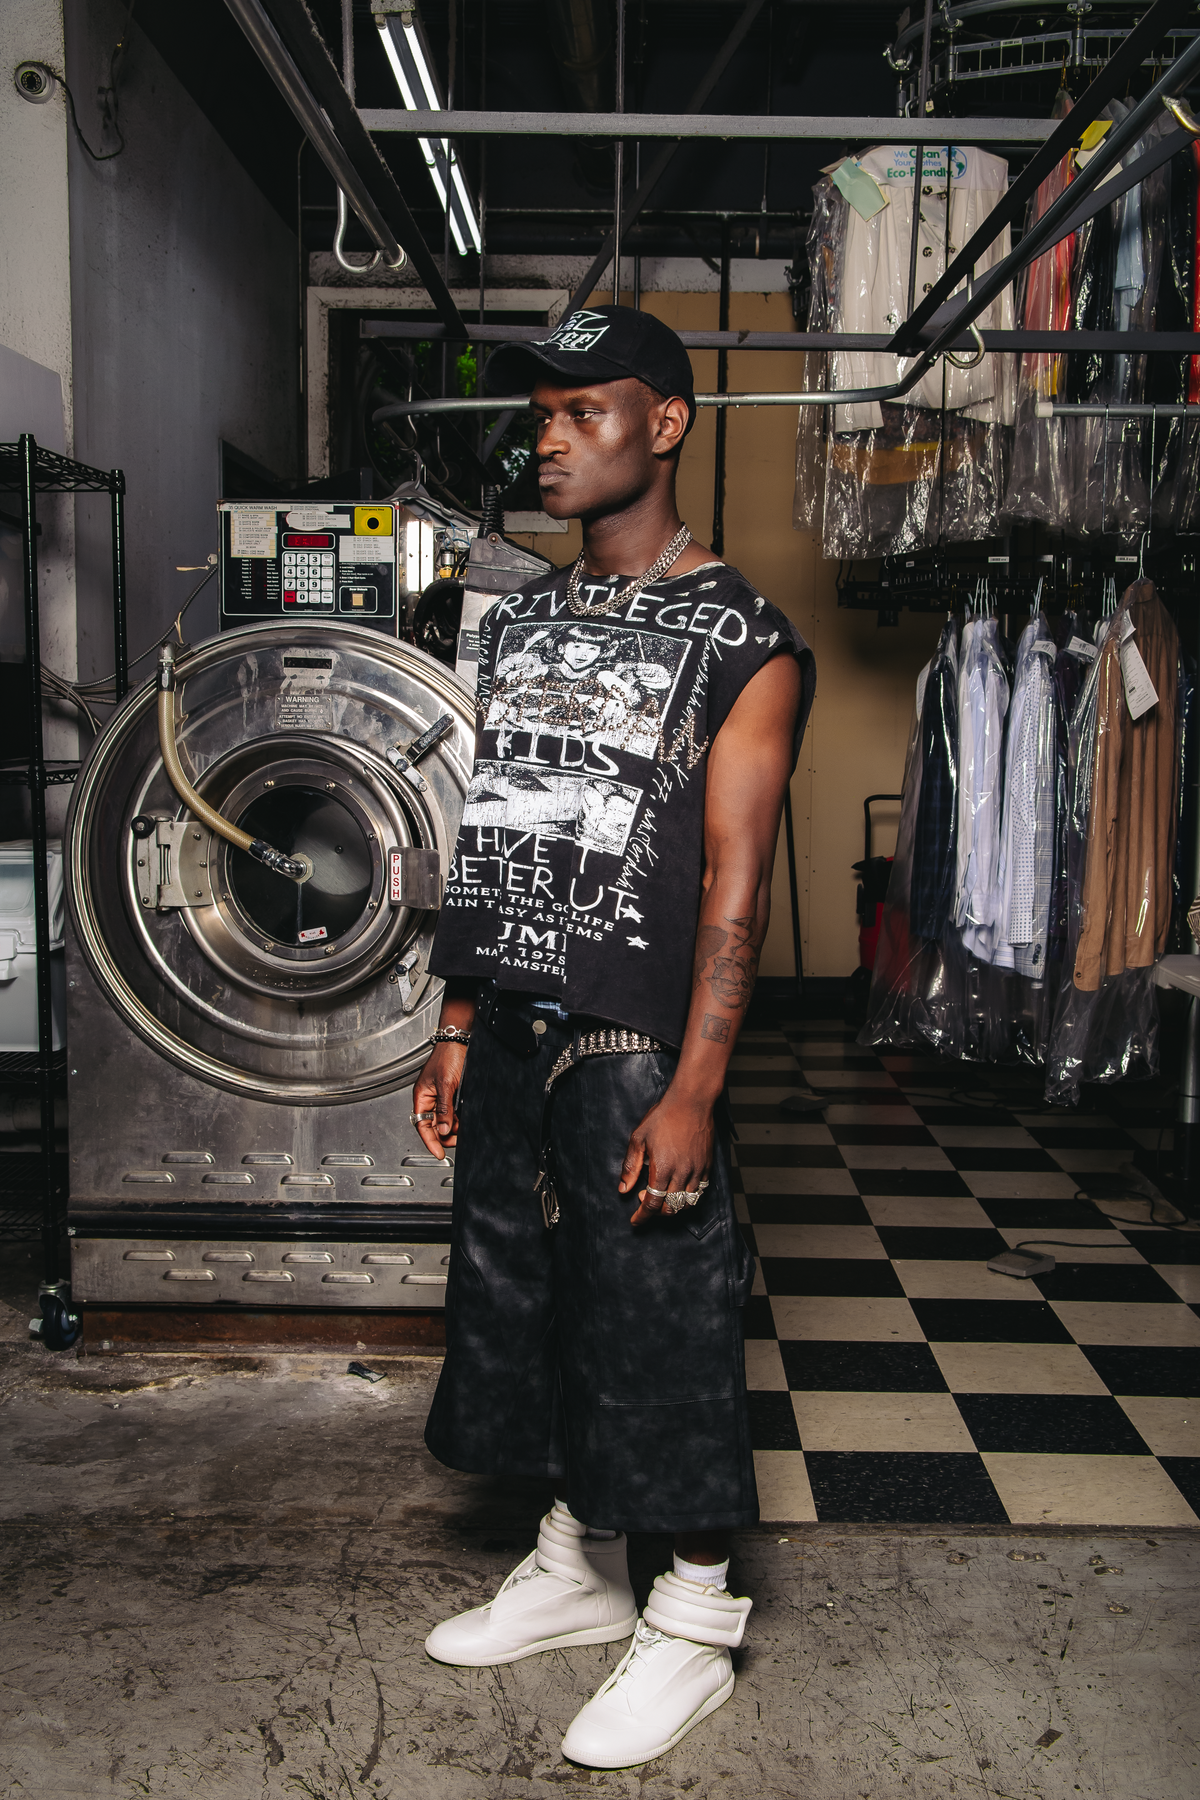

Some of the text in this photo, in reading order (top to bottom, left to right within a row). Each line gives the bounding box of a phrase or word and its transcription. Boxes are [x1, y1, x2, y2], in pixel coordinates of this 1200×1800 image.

[909, 148, 940, 158] Cean
[887, 167, 954, 178] Eco-Fendly.
[508, 894, 544, 909] THE
[571, 911, 615, 932] LIFE
